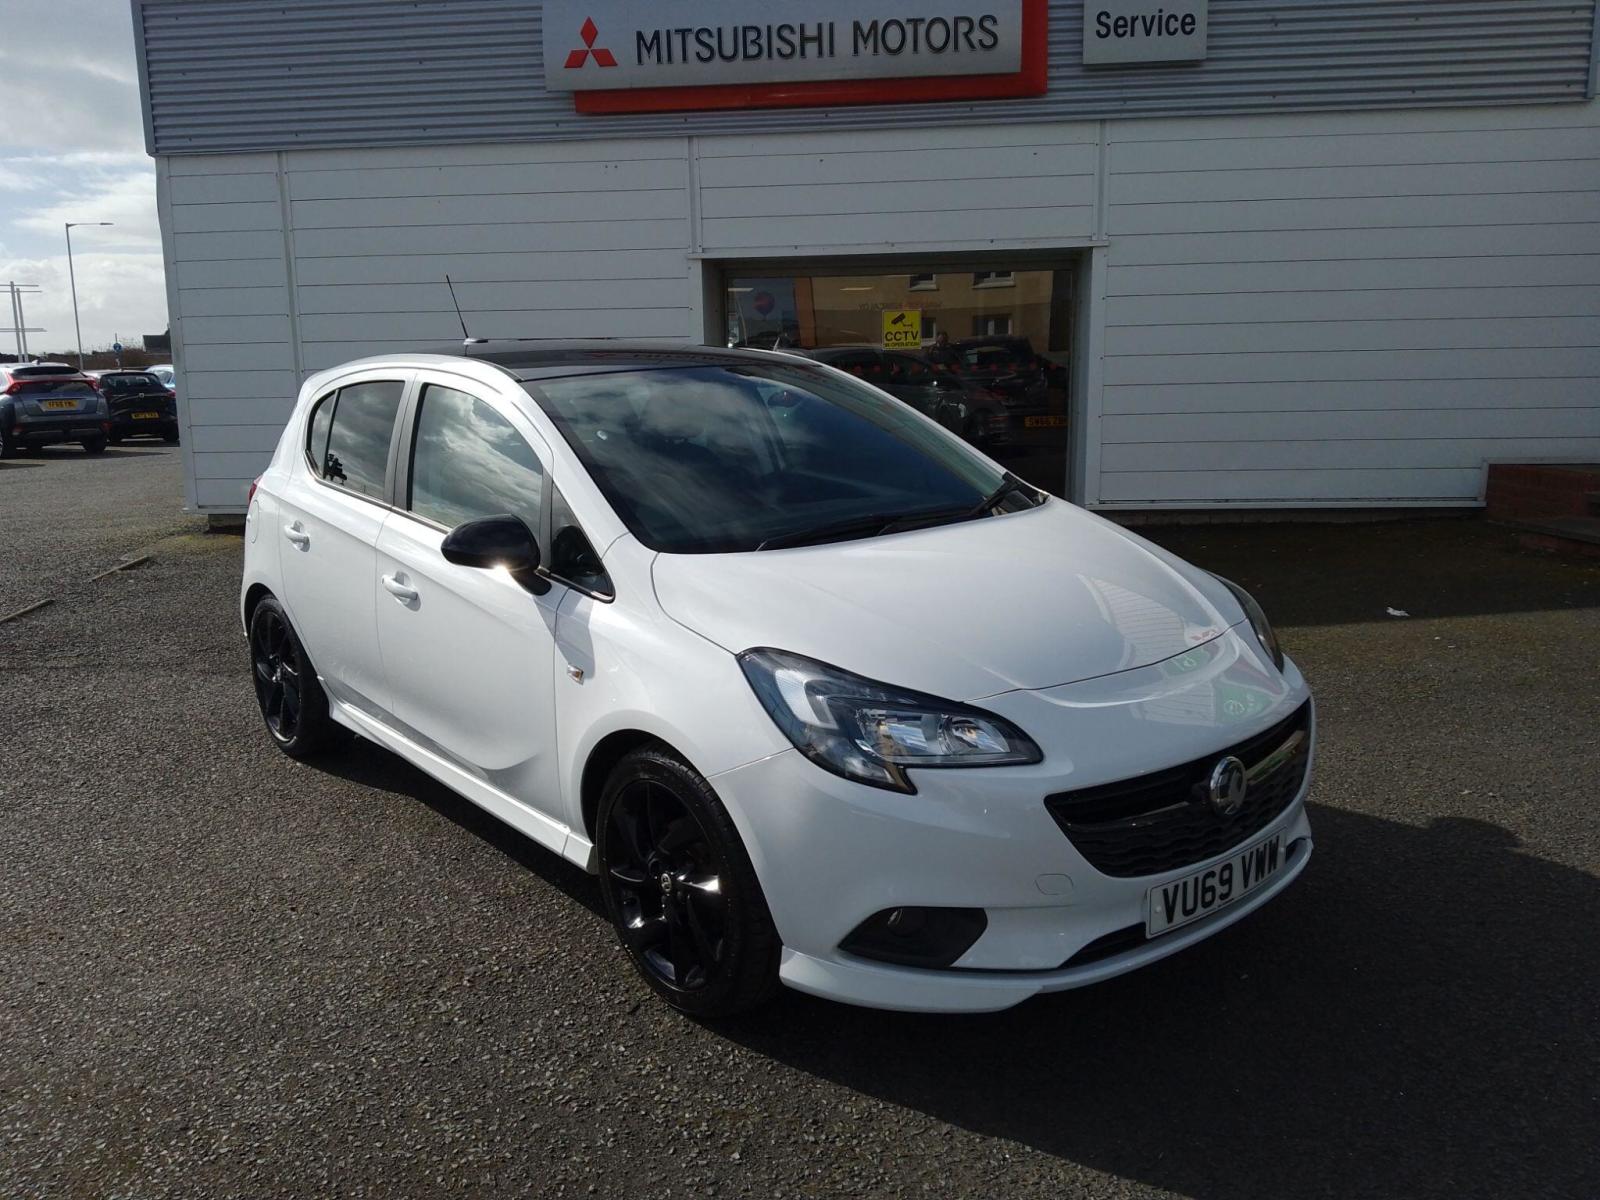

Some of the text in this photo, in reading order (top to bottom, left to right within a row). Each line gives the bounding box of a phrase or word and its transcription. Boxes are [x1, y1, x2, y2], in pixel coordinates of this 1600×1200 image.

[636, 15, 999, 66] MITSUBISHI MOTORS
[1096, 9, 1196, 39] Service
[885, 330, 918, 341] CCTV
[1163, 863, 1233, 924] VU69
